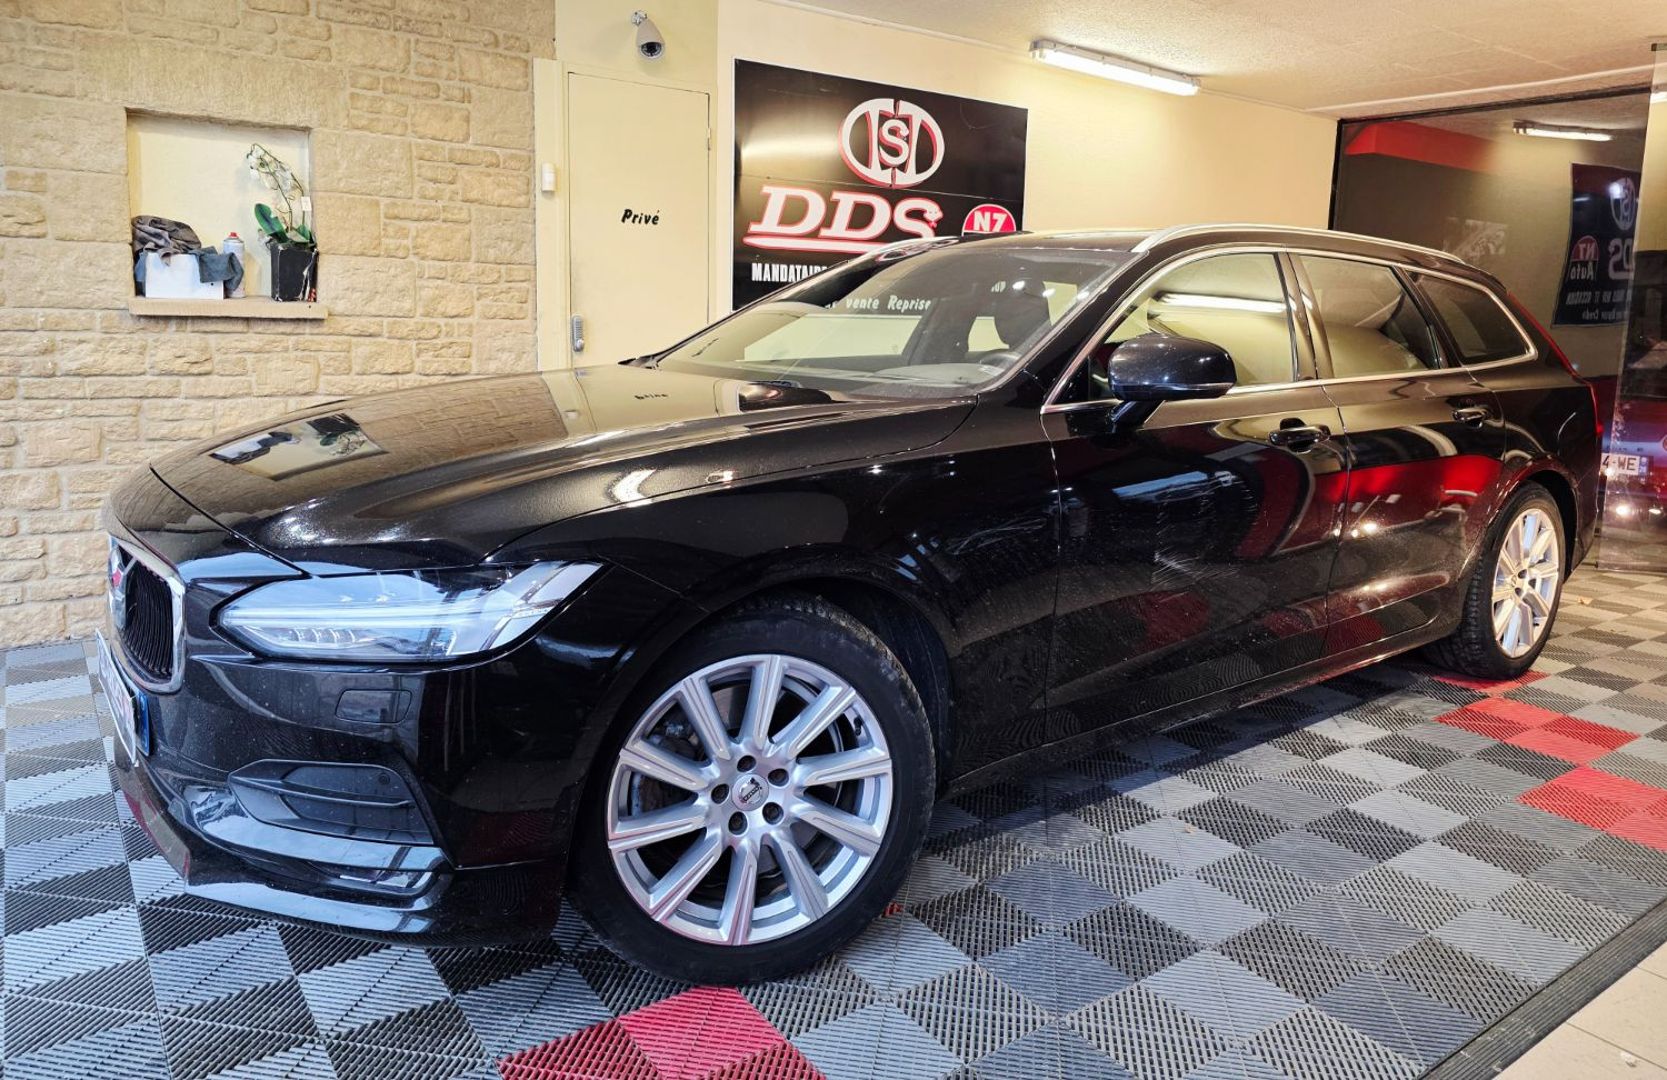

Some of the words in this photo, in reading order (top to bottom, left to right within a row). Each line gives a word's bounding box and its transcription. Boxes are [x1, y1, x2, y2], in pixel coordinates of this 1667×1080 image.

[621, 208, 660, 225] Privé
[747, 186, 943, 240] DDS
[973, 210, 1008, 232] N7
[751, 262, 828, 283] MANDATAI
